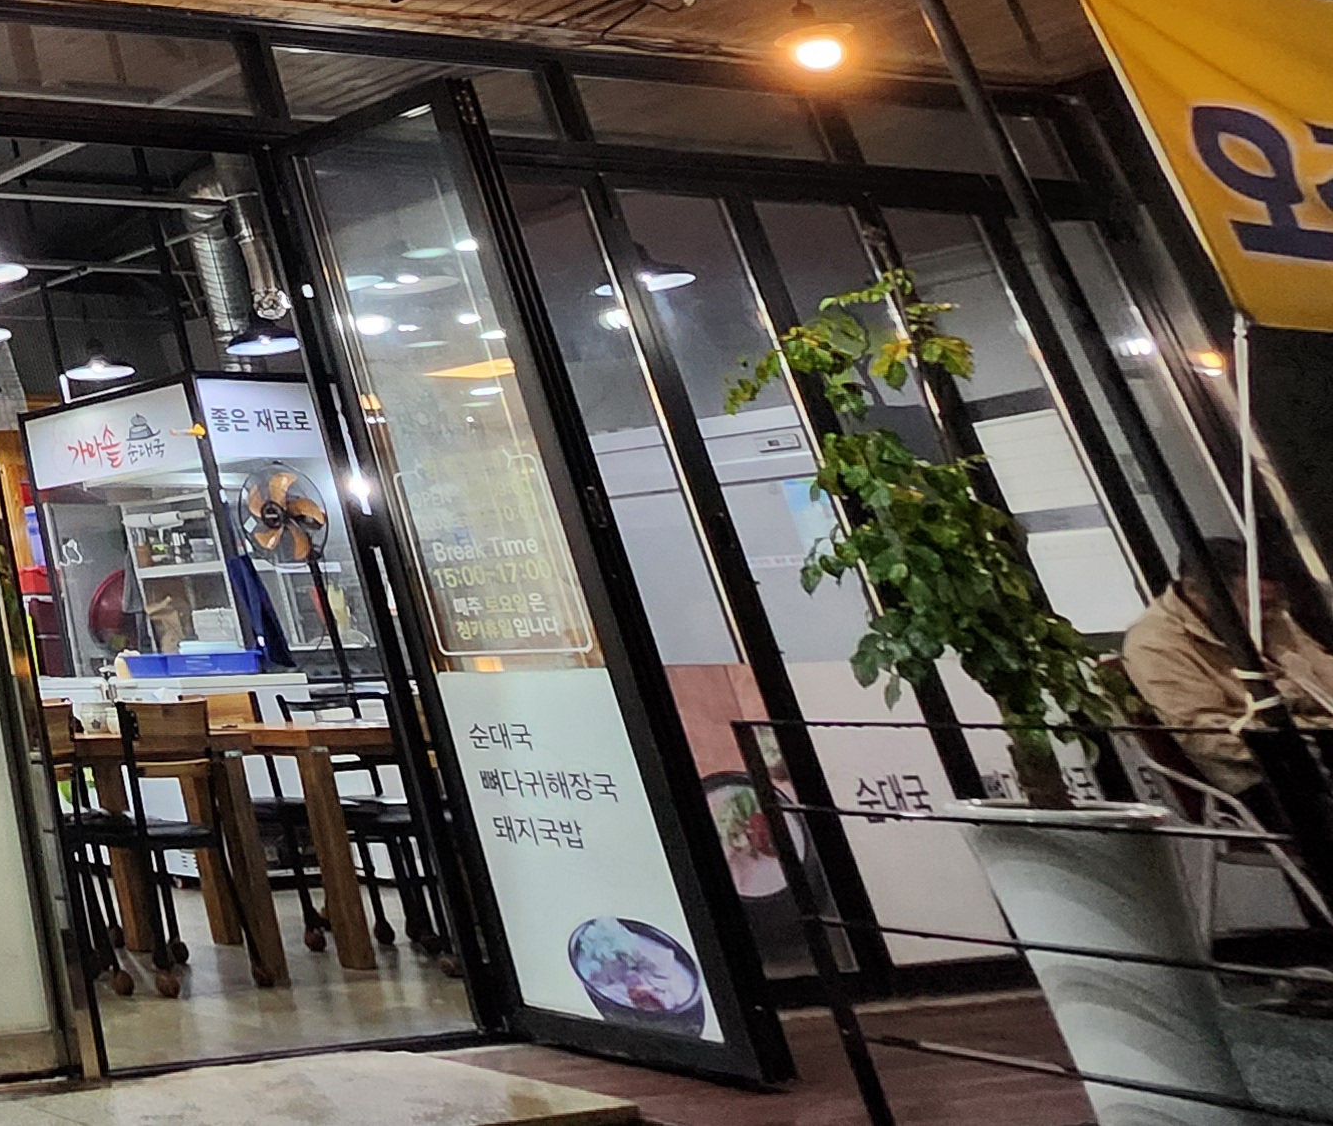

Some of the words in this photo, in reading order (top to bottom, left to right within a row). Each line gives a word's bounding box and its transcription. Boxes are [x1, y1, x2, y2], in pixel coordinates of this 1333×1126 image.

[1191, 105, 1333, 261] 오
[211, 407, 249, 433] 좋은
[253, 410, 314, 434] 재료로
[126, 441, 166, 466] 순대국
[434, 539, 487, 563] Break
[492, 536, 539, 558] Time
[485, 592, 546, 614] 토요일은
[457, 616, 561, 641] 정기휴일입니다
[469, 722, 534, 751] 순대국
[479, 768, 619, 804] 뼈다귀해장국
[492, 815, 585, 850] 돼지국밥
